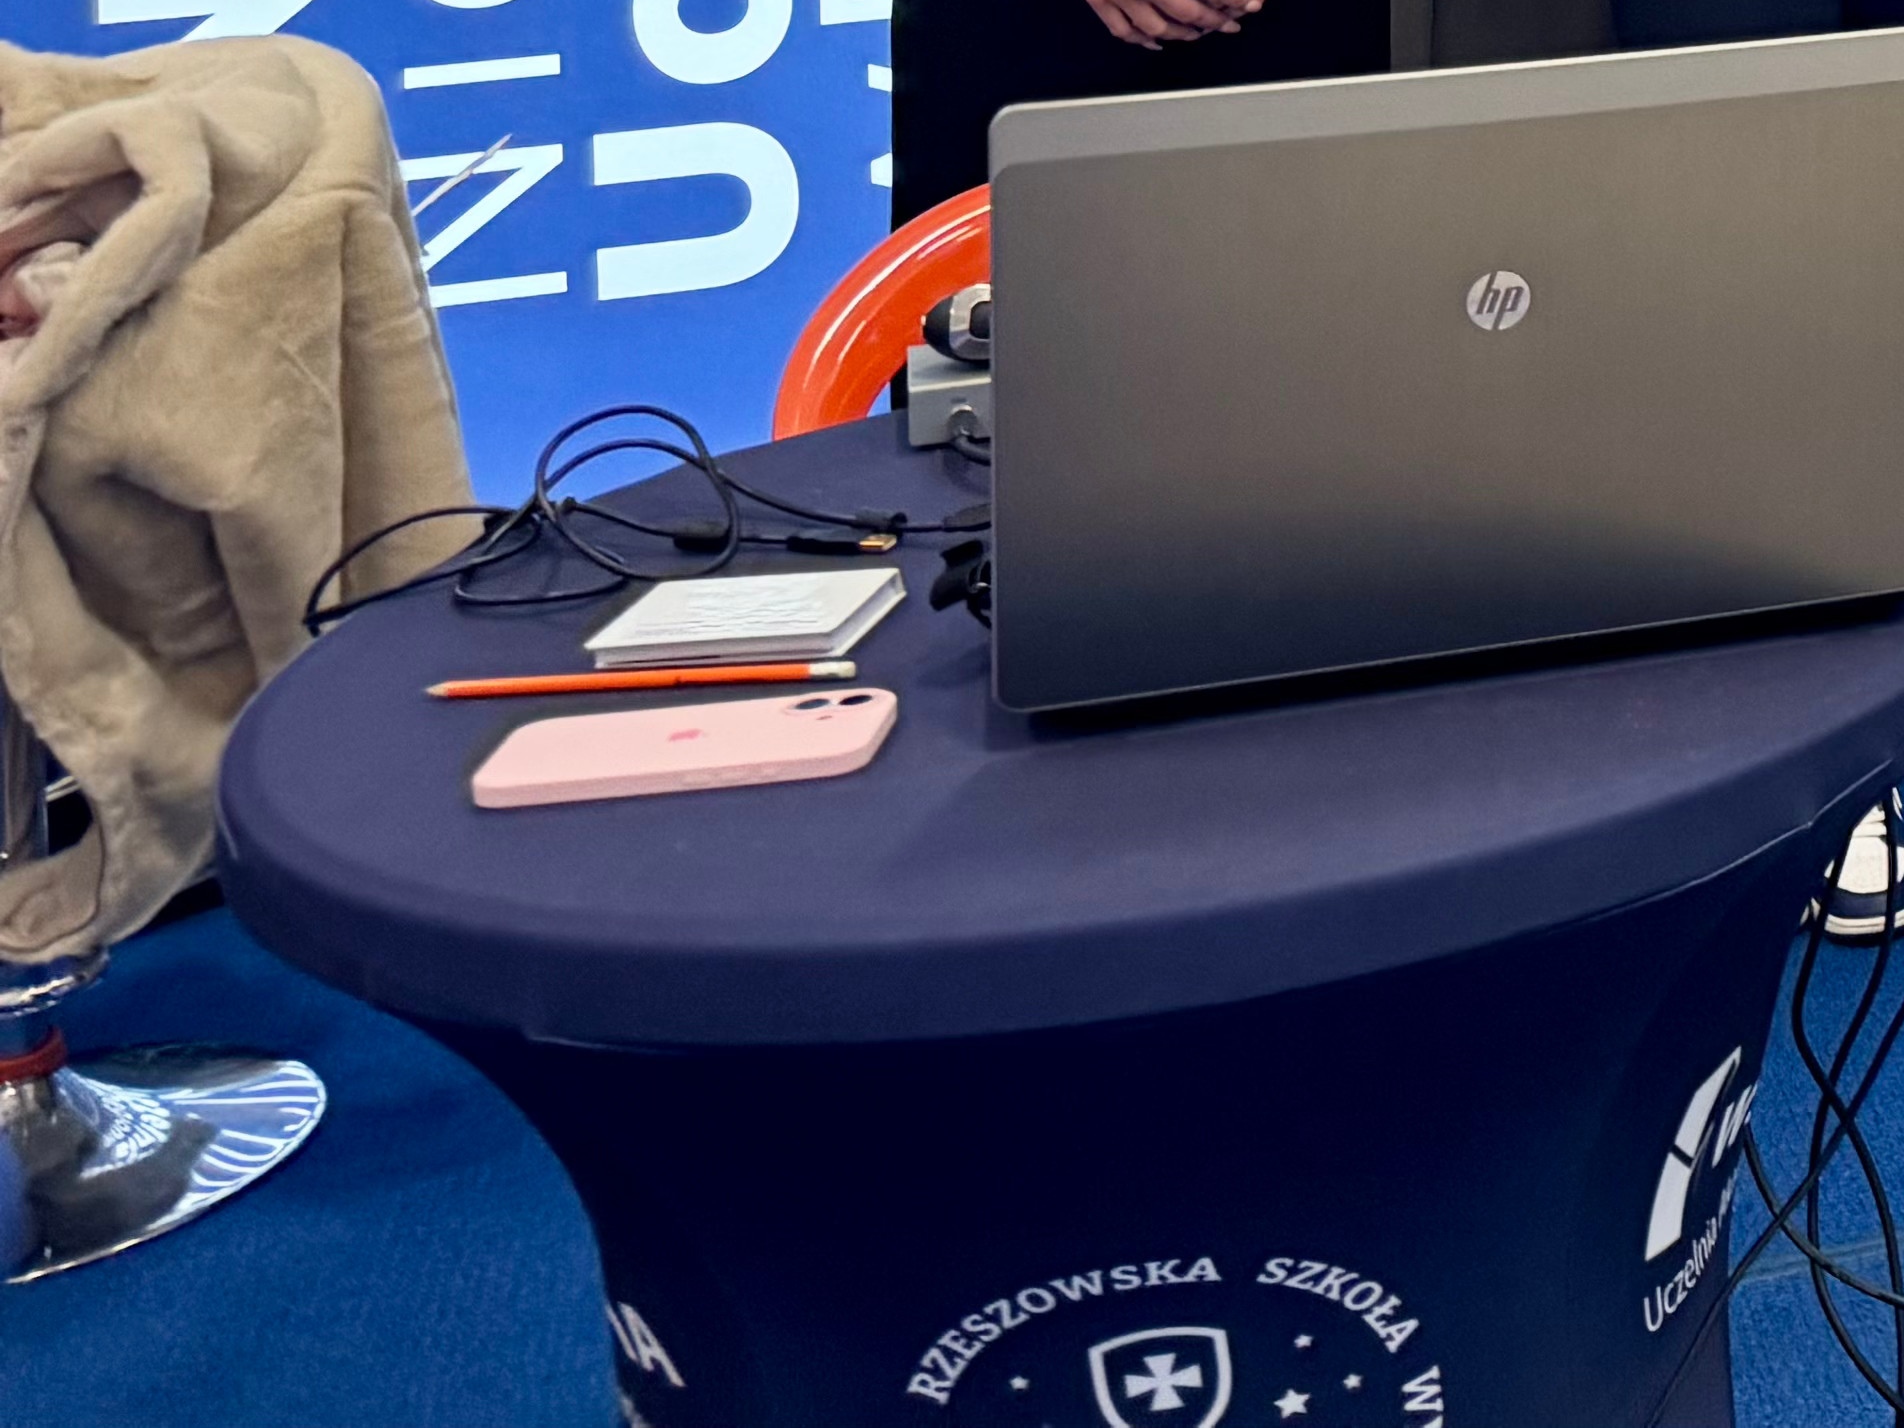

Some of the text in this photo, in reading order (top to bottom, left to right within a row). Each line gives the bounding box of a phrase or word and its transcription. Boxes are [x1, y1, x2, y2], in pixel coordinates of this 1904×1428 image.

[1474, 270, 1523, 332] hp
[907, 1256, 1420, 1405] RZESZOWSKA SZKOŁA
